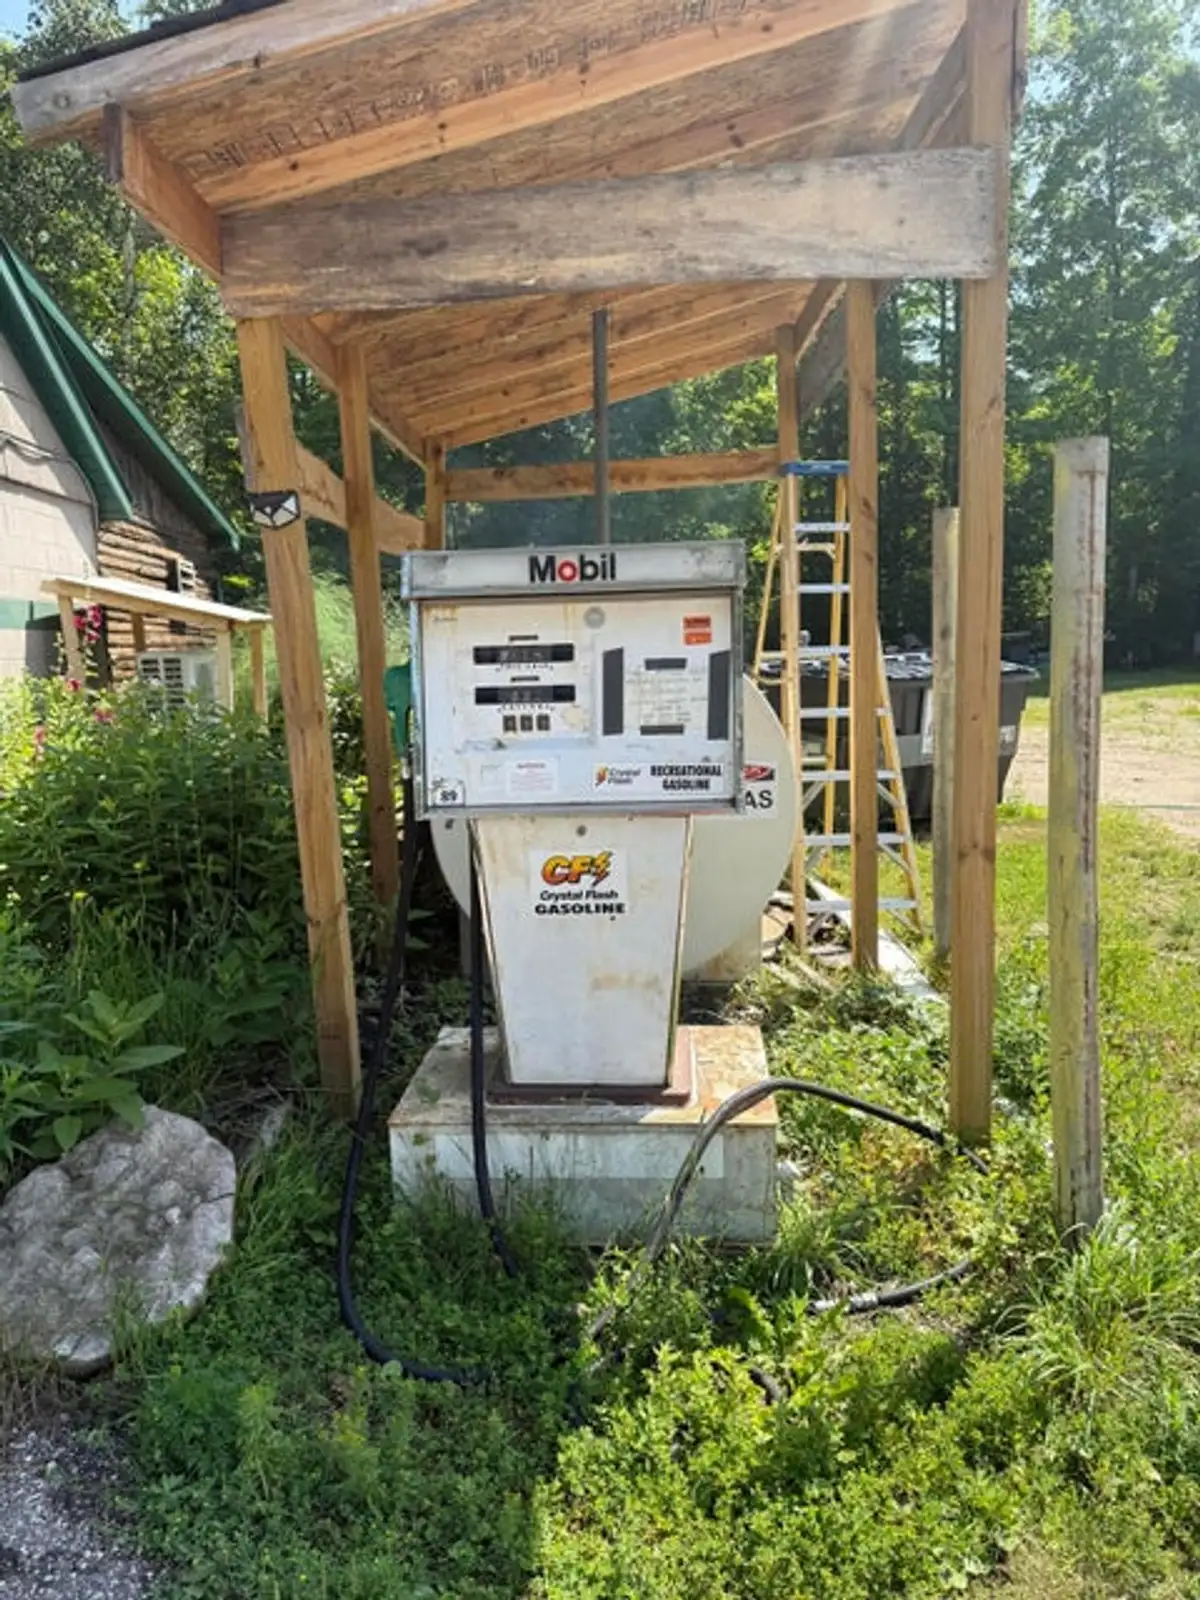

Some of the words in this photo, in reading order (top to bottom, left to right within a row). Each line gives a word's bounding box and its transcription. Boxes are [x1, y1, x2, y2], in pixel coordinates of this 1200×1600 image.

[528, 552, 616, 583] Mobil
[650, 765, 721, 777] RECREATIONAL
[662, 780, 710, 791] GASOLINE
[540, 890, 583, 902] Crystal
[585, 890, 619, 900] Flash
[534, 902, 625, 914] GASOLINE
